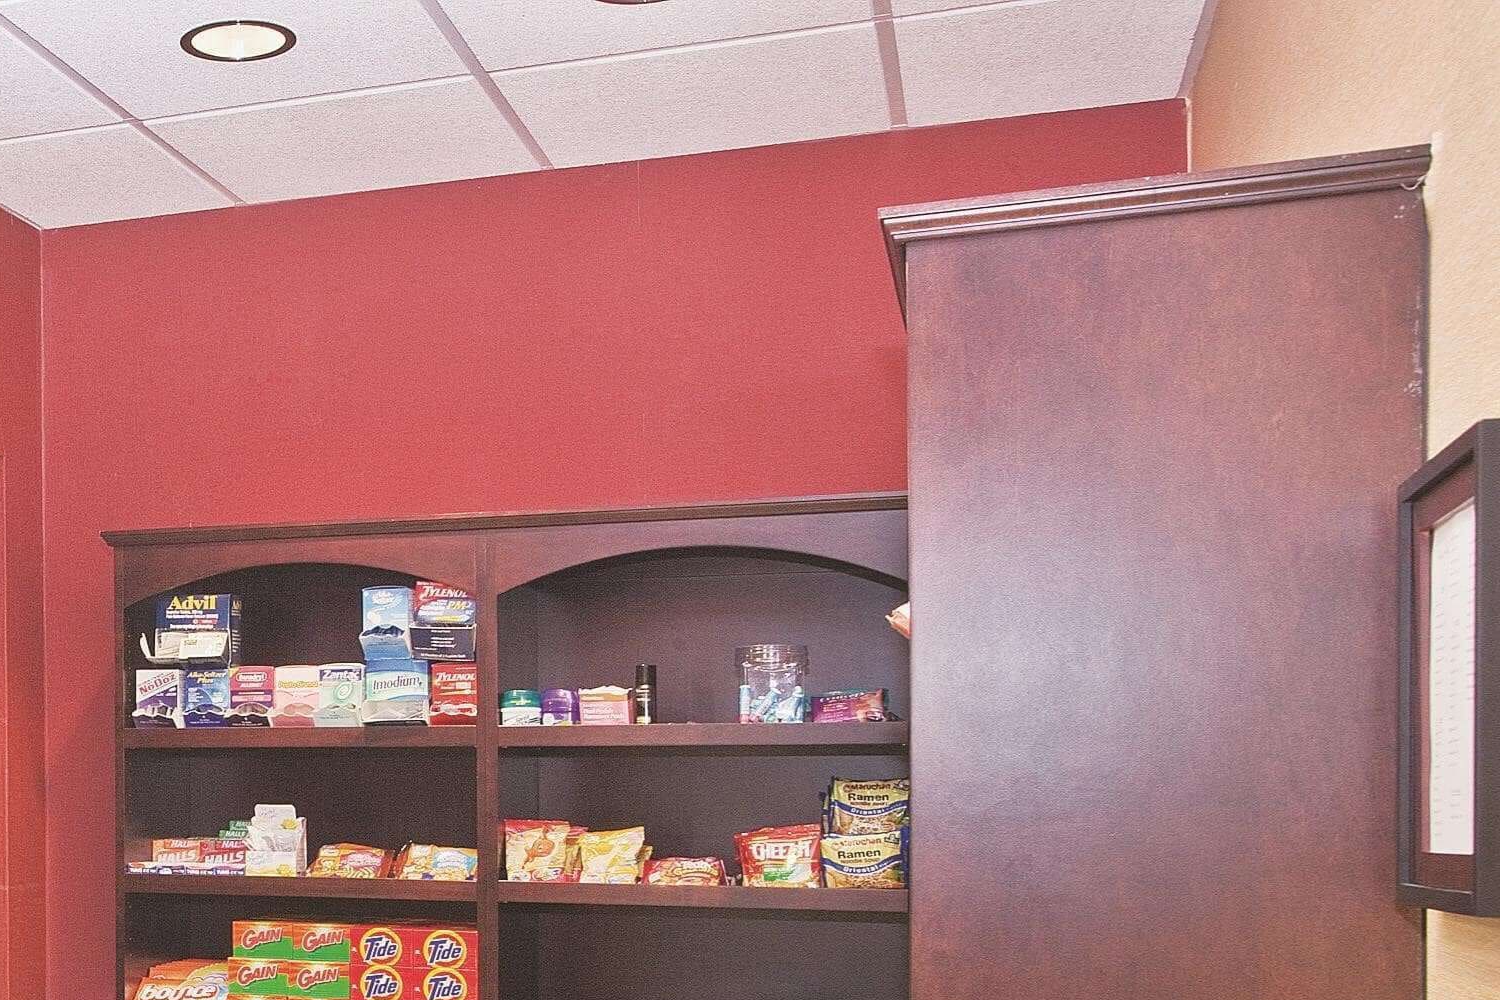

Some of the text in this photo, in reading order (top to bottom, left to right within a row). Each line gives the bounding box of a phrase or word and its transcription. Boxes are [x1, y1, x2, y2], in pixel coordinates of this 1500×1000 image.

[421, 585, 468, 600] TYLENOL
[167, 595, 218, 610] Advil
[139, 672, 178, 696] NoDoz
[373, 675, 421, 691] Imodium
[847, 793, 889, 802] Ramen
[157, 851, 195, 863] HALLS
[205, 850, 244, 863] HALLS
[837, 850, 882, 860] Ramen
[242, 928, 283, 947] GAIN
[303, 929, 345, 948] GAIN
[365, 936, 397, 960] Tide
[428, 939, 462, 965] Tide
[238, 965, 279, 985] GAIN
[298, 967, 340, 988] GAIN
[365, 973, 397, 998] Tide
